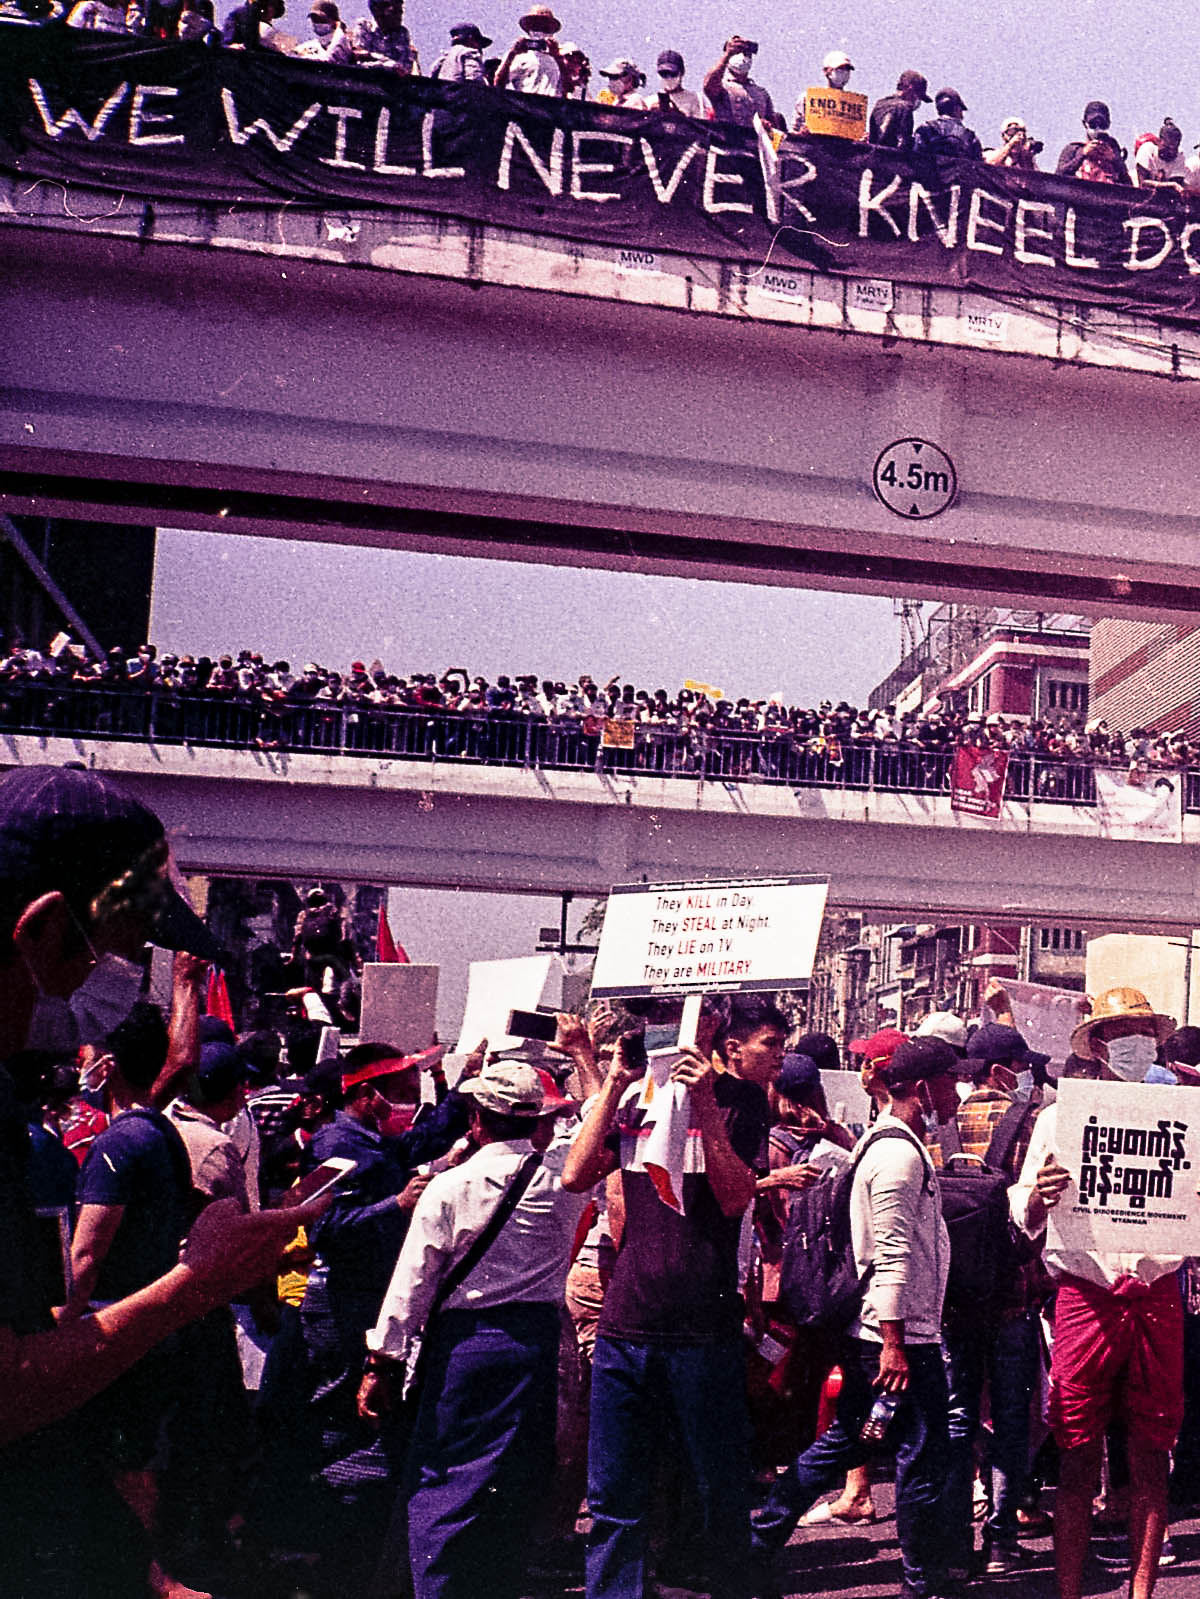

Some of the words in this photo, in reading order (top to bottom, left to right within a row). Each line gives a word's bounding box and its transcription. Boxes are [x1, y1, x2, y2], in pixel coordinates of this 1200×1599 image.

[29, 78, 185, 145] WE
[221, 87, 466, 178] WILL
[497, 121, 818, 224] NEVER
[858, 168, 1100, 269] KNEEL
[620, 252, 655, 264] MWD
[764, 275, 798, 290] MWD
[881, 461, 948, 492] 4.5m
[656, 897, 681, 913] They
[686, 895, 712, 909] KILL
[716, 895, 727, 907] in
[652, 919, 679, 935] They
[682, 917, 716, 931] STEAL
[721, 915, 733, 929] at
[648, 942, 674, 958] They
[677, 940, 696, 955] LIE
[699, 941, 713, 953] on
[643, 965, 670, 981] They
[673, 965, 692, 978] are
[1072, 1206, 1091, 1214] CIVIL
